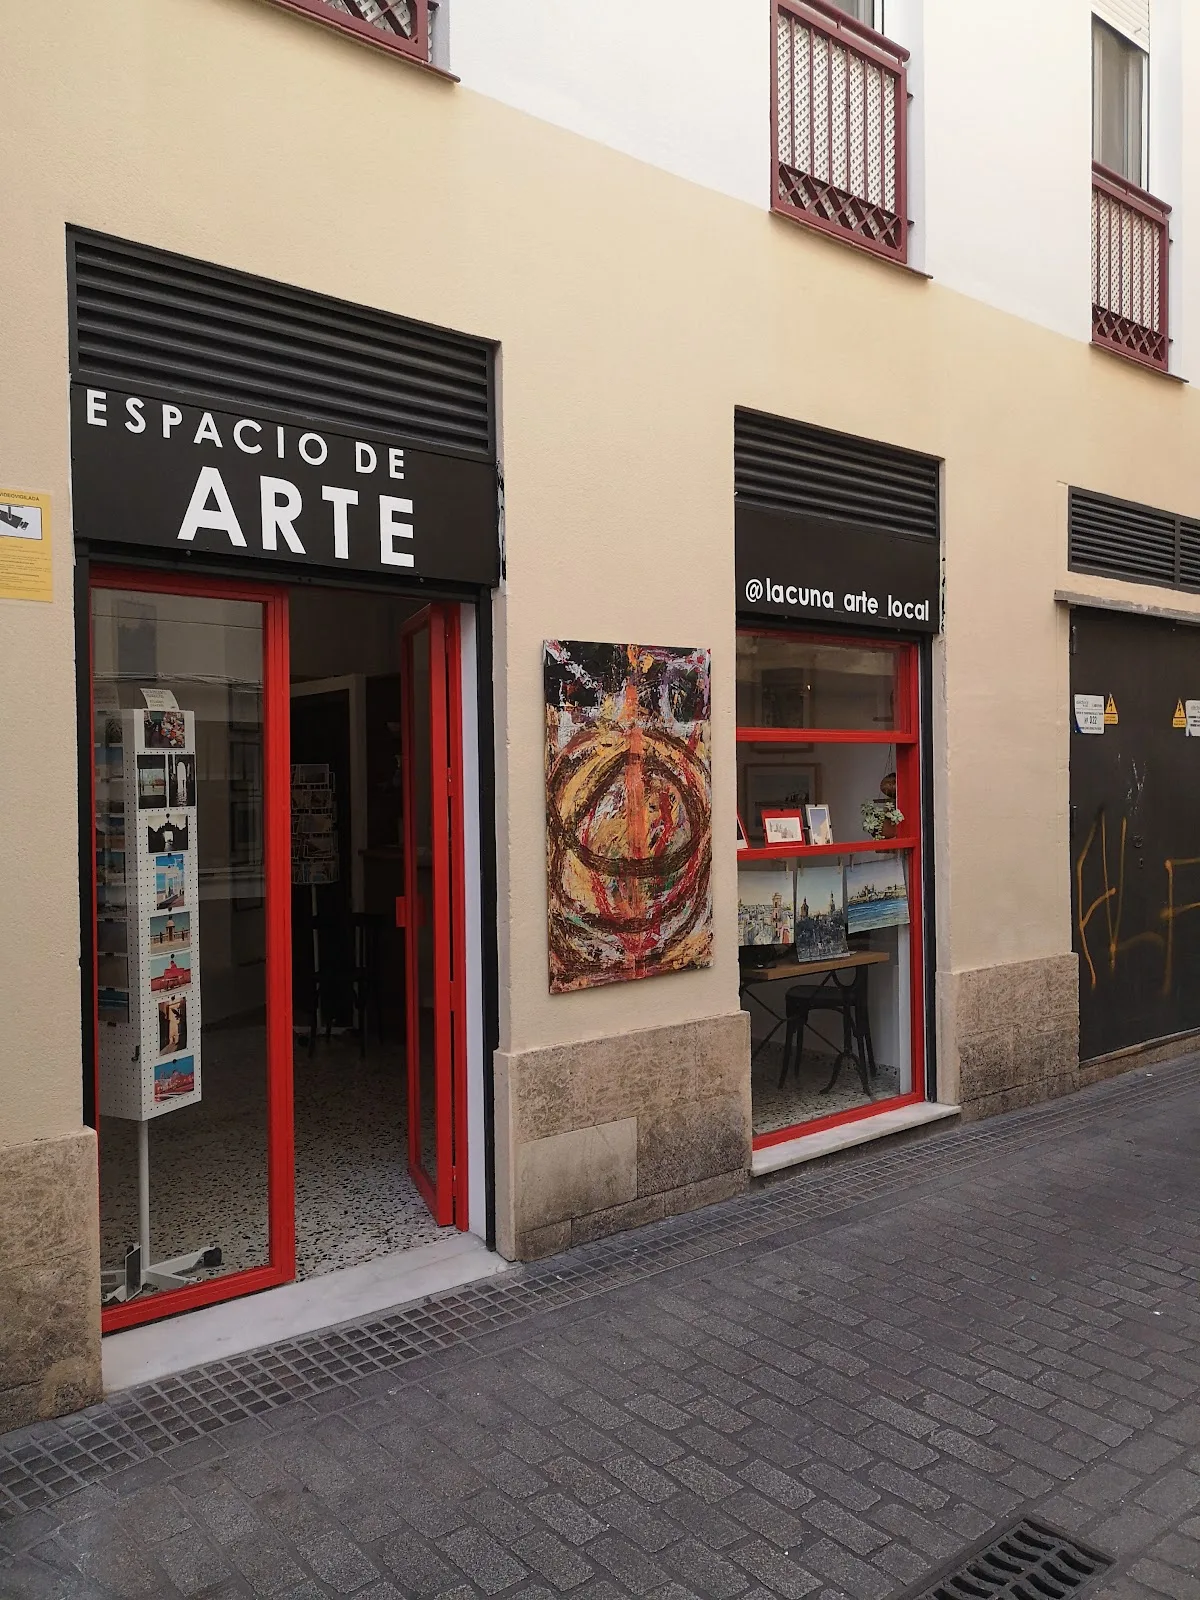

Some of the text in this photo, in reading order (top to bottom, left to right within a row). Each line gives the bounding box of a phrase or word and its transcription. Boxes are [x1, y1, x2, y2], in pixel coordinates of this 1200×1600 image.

[86, 388, 405, 480] ESPACIO DE
[177, 466, 415, 568] ARTE
